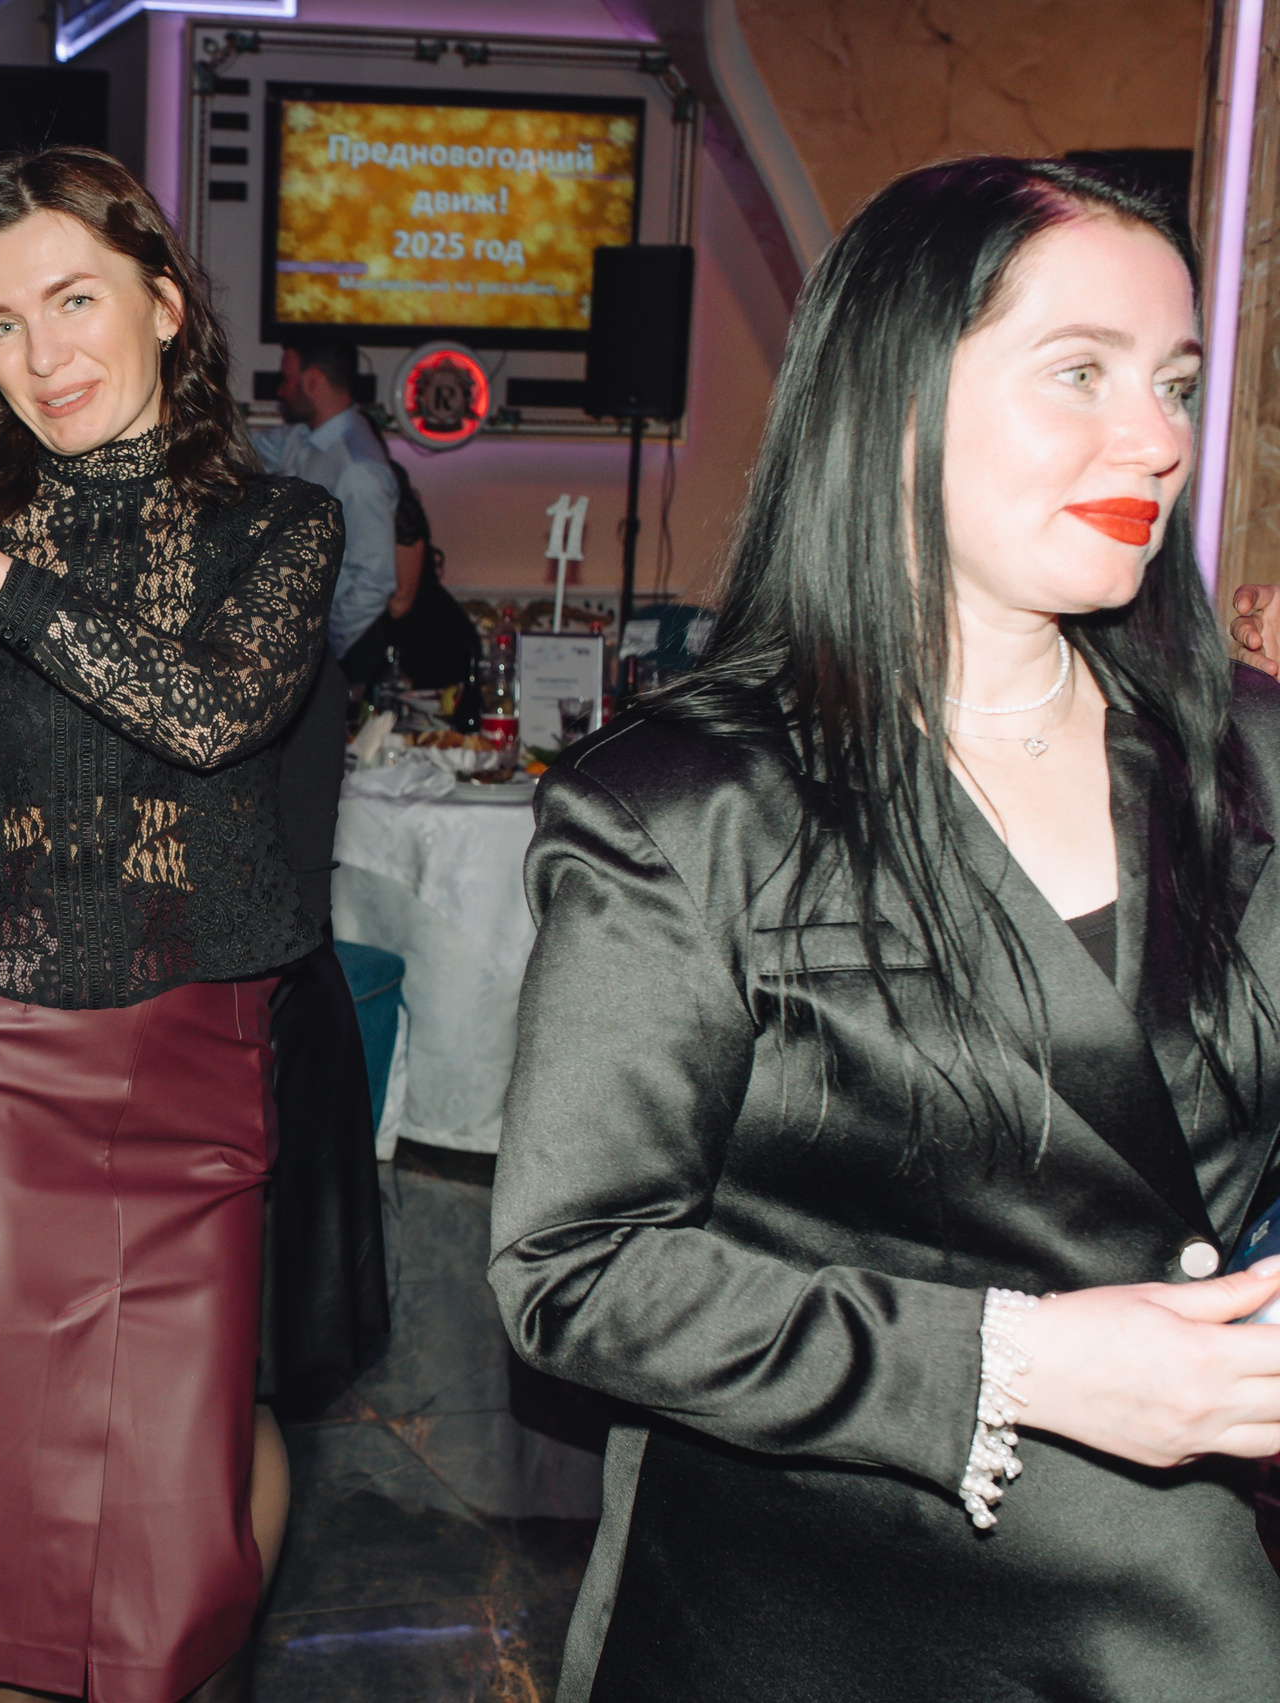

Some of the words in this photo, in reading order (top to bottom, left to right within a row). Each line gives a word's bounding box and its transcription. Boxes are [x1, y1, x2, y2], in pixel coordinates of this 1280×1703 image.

[328, 133, 595, 175] Предновогодний
[410, 184, 509, 218] движ!
[392, 229, 466, 260] 2025
[473, 238, 526, 267] год
[545, 493, 589, 561] 11
